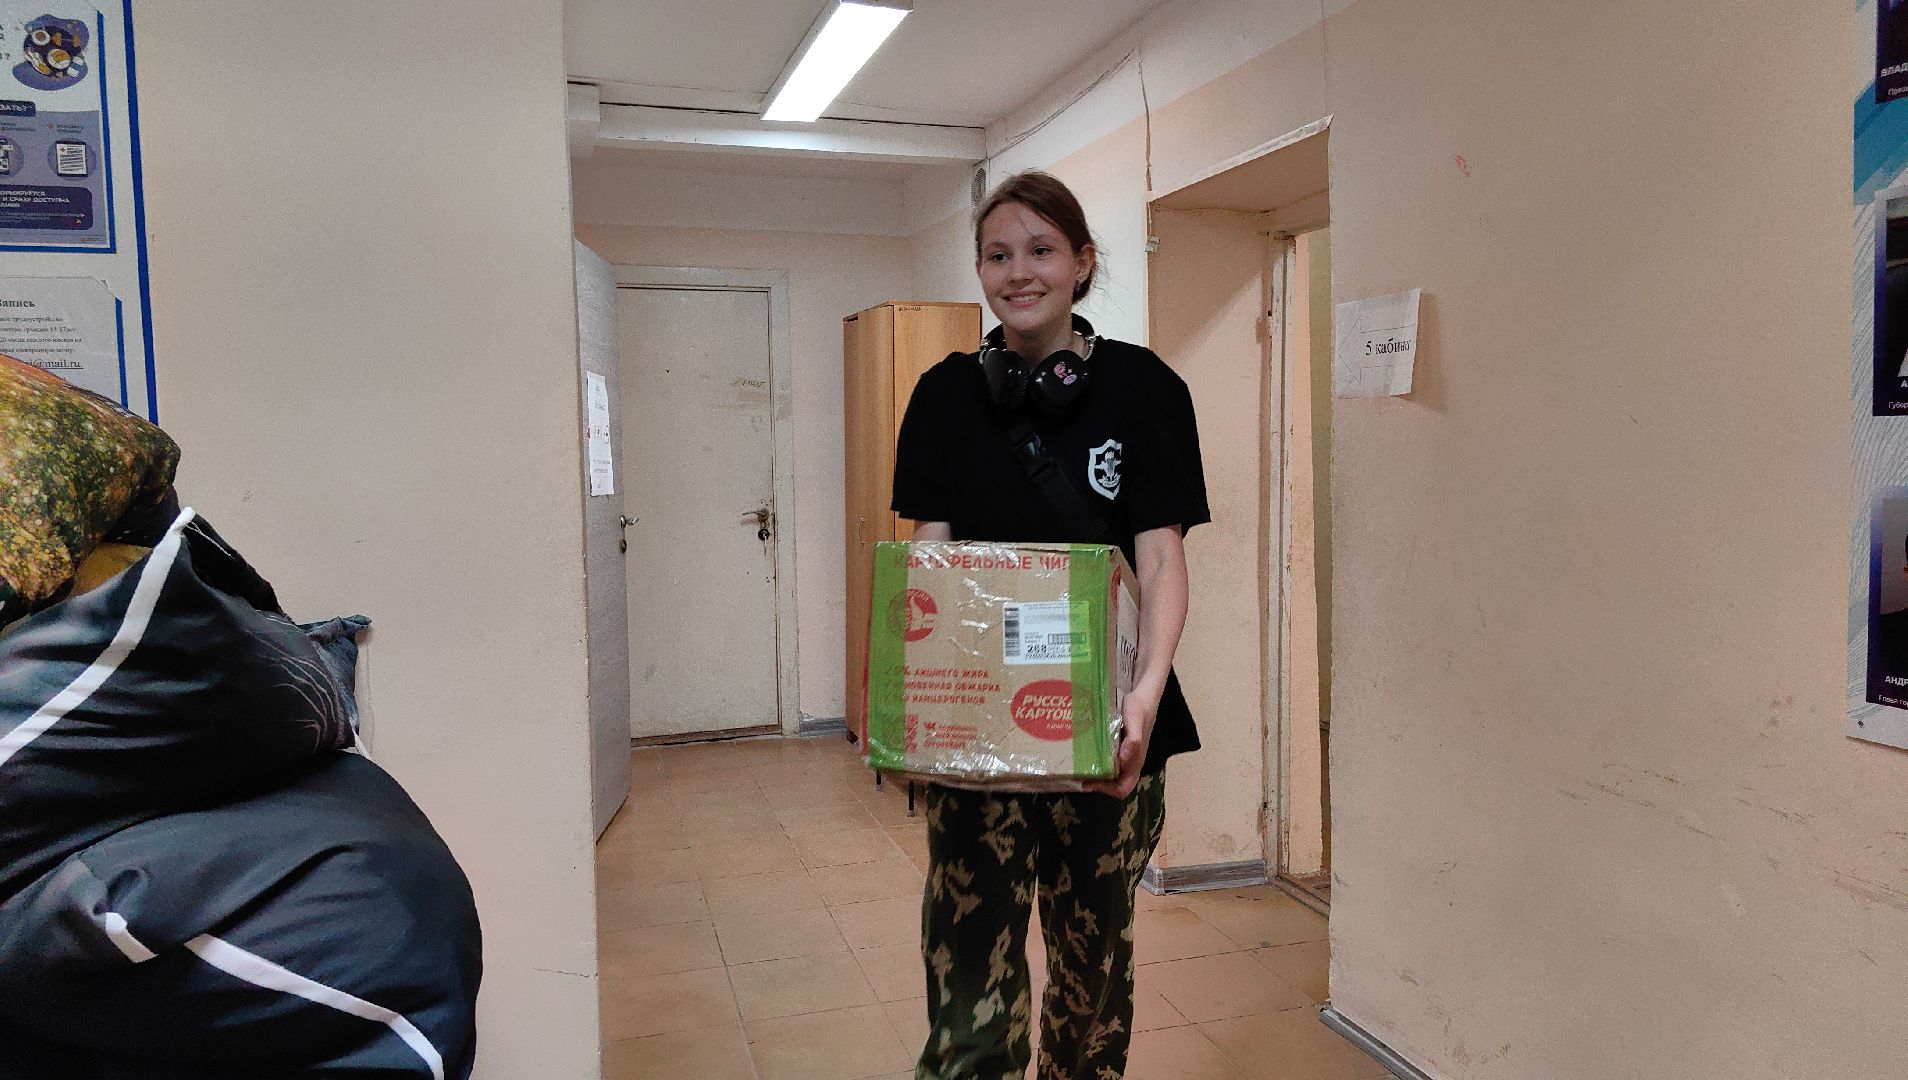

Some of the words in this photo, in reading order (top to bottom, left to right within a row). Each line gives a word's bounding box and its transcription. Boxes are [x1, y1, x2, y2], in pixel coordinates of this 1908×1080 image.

[1365, 340, 1372, 356] 5
[1022, 694, 1083, 708] РУССК
[1014, 705, 1086, 721] КАРТОШ
